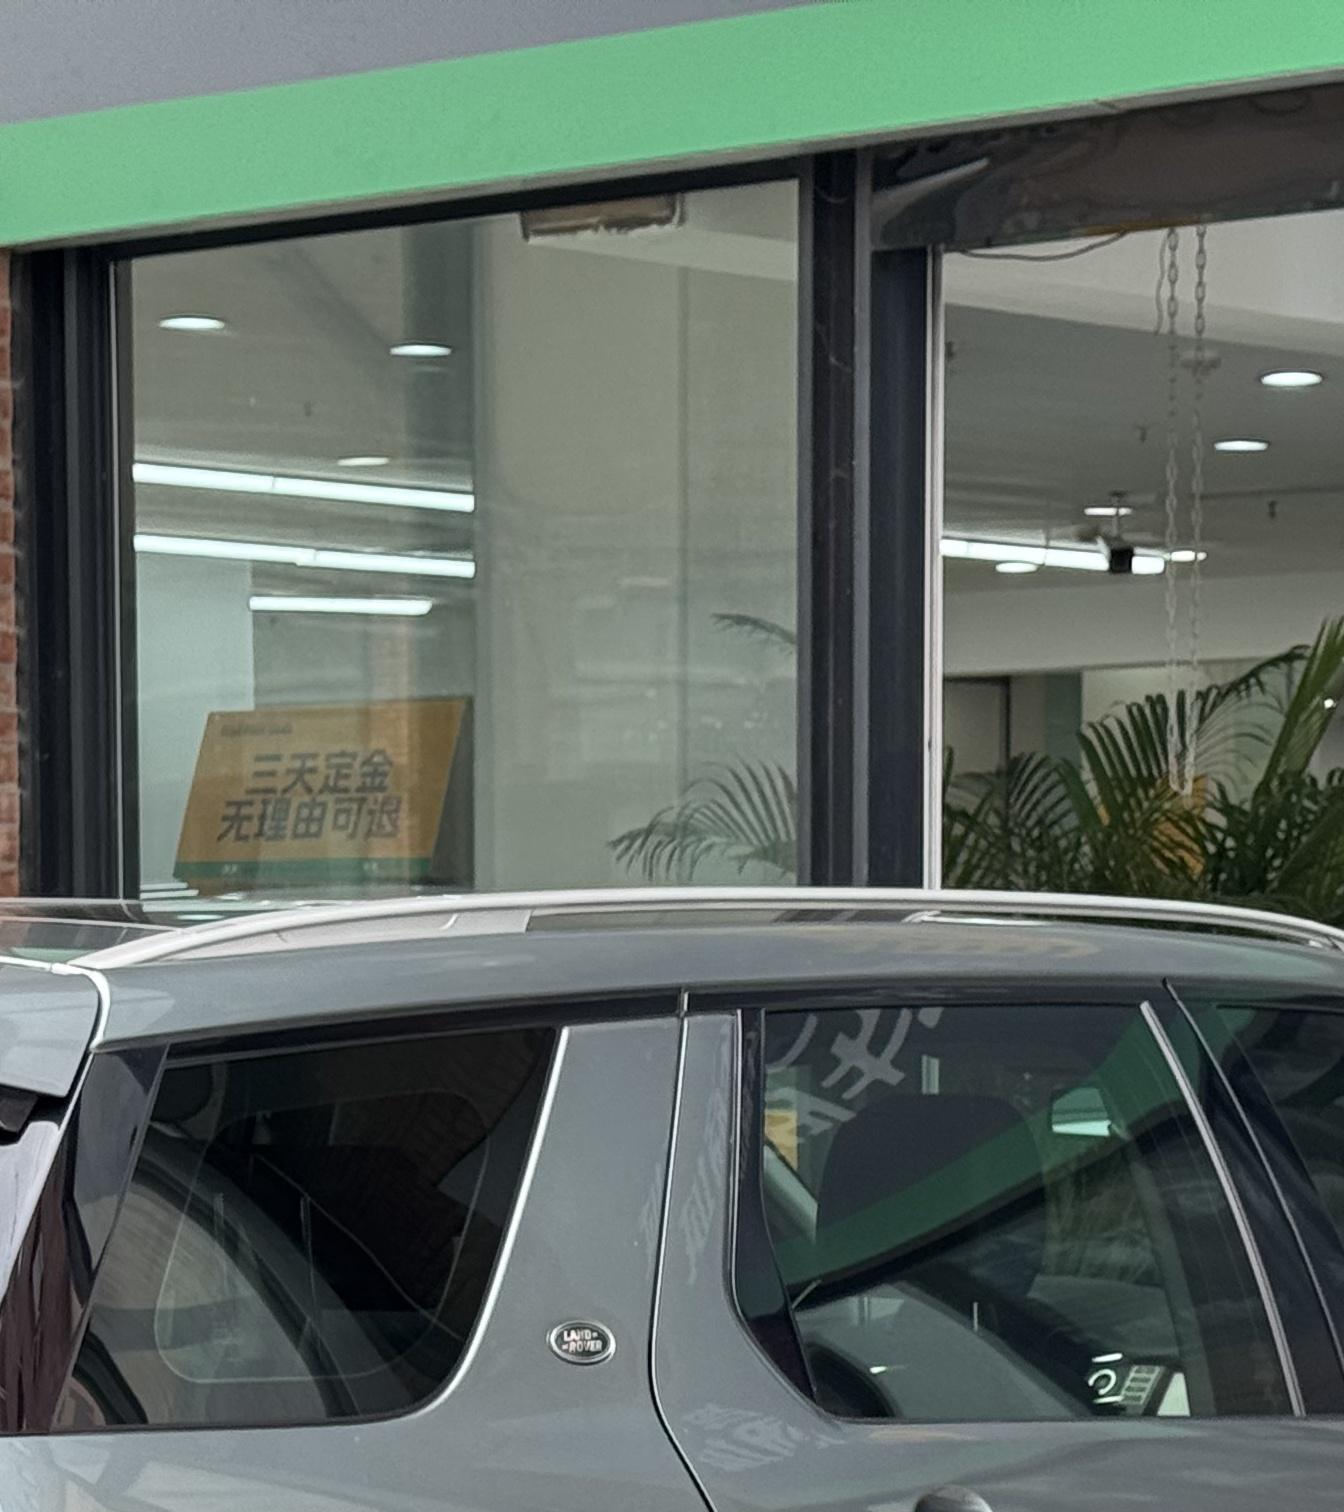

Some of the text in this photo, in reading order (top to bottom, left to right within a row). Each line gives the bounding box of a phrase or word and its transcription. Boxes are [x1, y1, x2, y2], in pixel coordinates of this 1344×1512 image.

[245, 749, 394, 796] 三天定金
[216, 795, 403, 842] 无理由可退
[563, 1329, 592, 1341] LAND
[568, 1340, 603, 1353] ROVER
